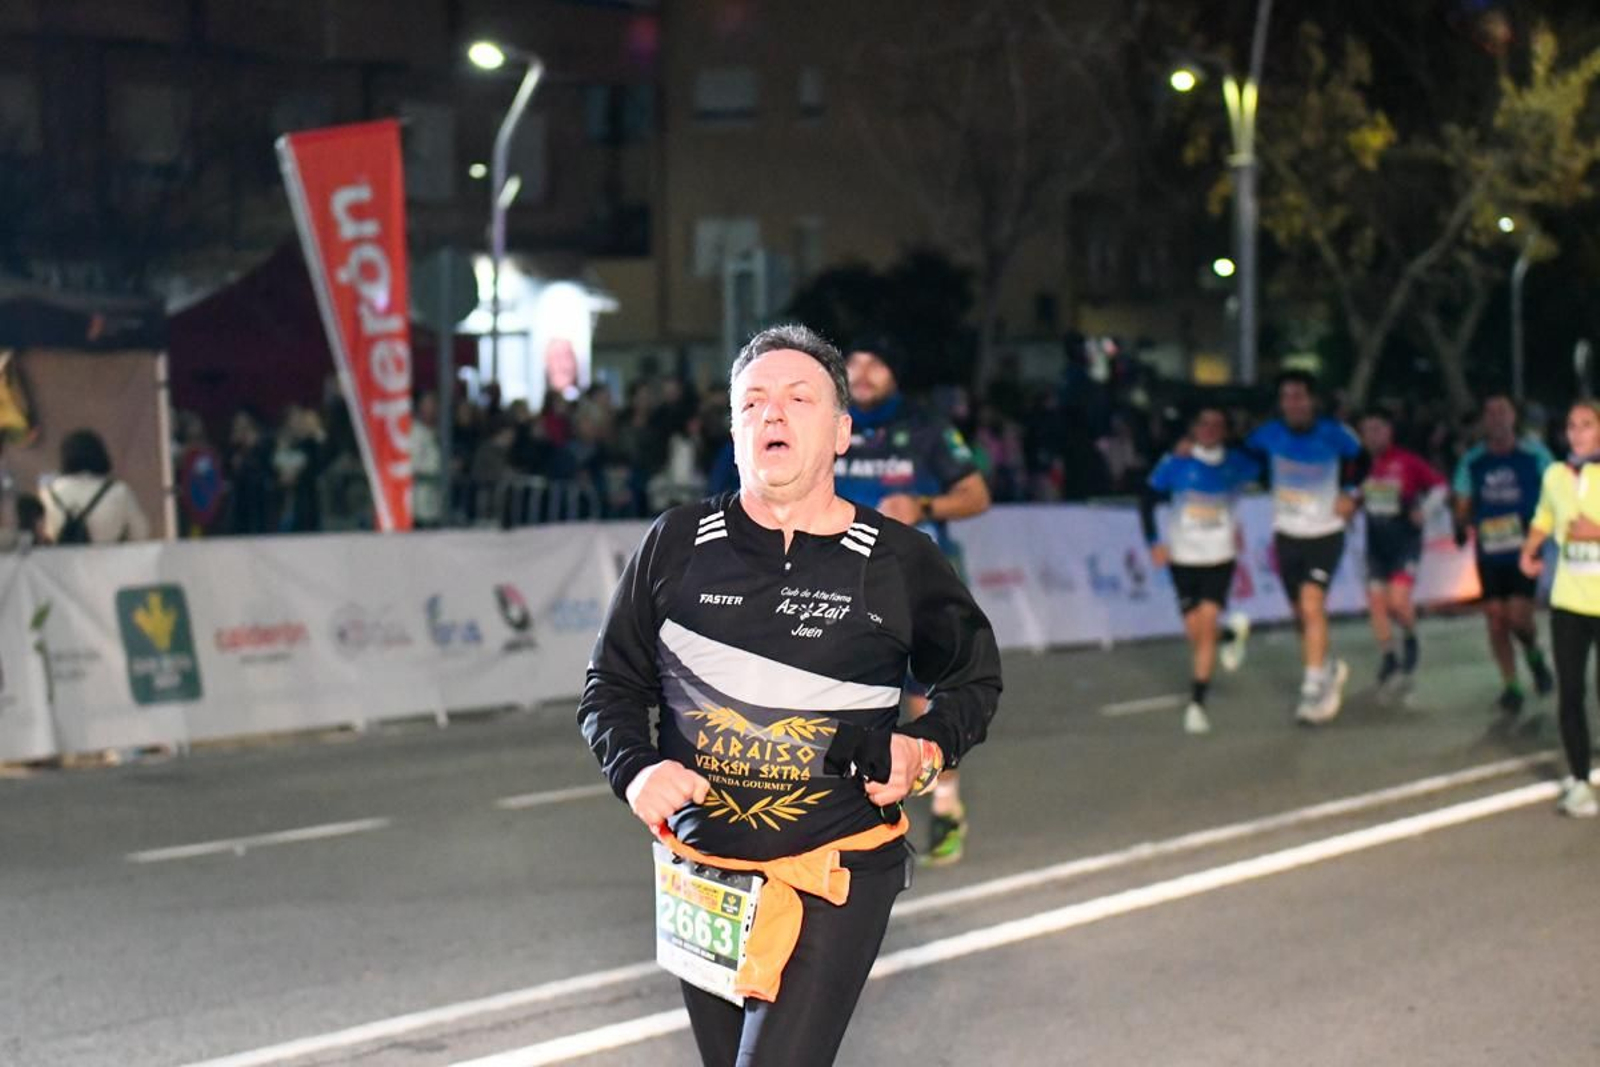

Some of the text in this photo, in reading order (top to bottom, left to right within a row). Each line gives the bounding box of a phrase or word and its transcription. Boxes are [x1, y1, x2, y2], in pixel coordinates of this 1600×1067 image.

[699, 593, 744, 606] FASTER
[780, 586, 800, 597] Club
[800, 589, 811, 599] de
[775, 598, 851, 620] Az Zait
[697, 730, 815, 764] PARAISO
[695, 754, 812, 781] VIRGEN EXTRA
[708, 774, 793, 792] TIENDA GOURMET
[658, 893, 734, 956] 2663
